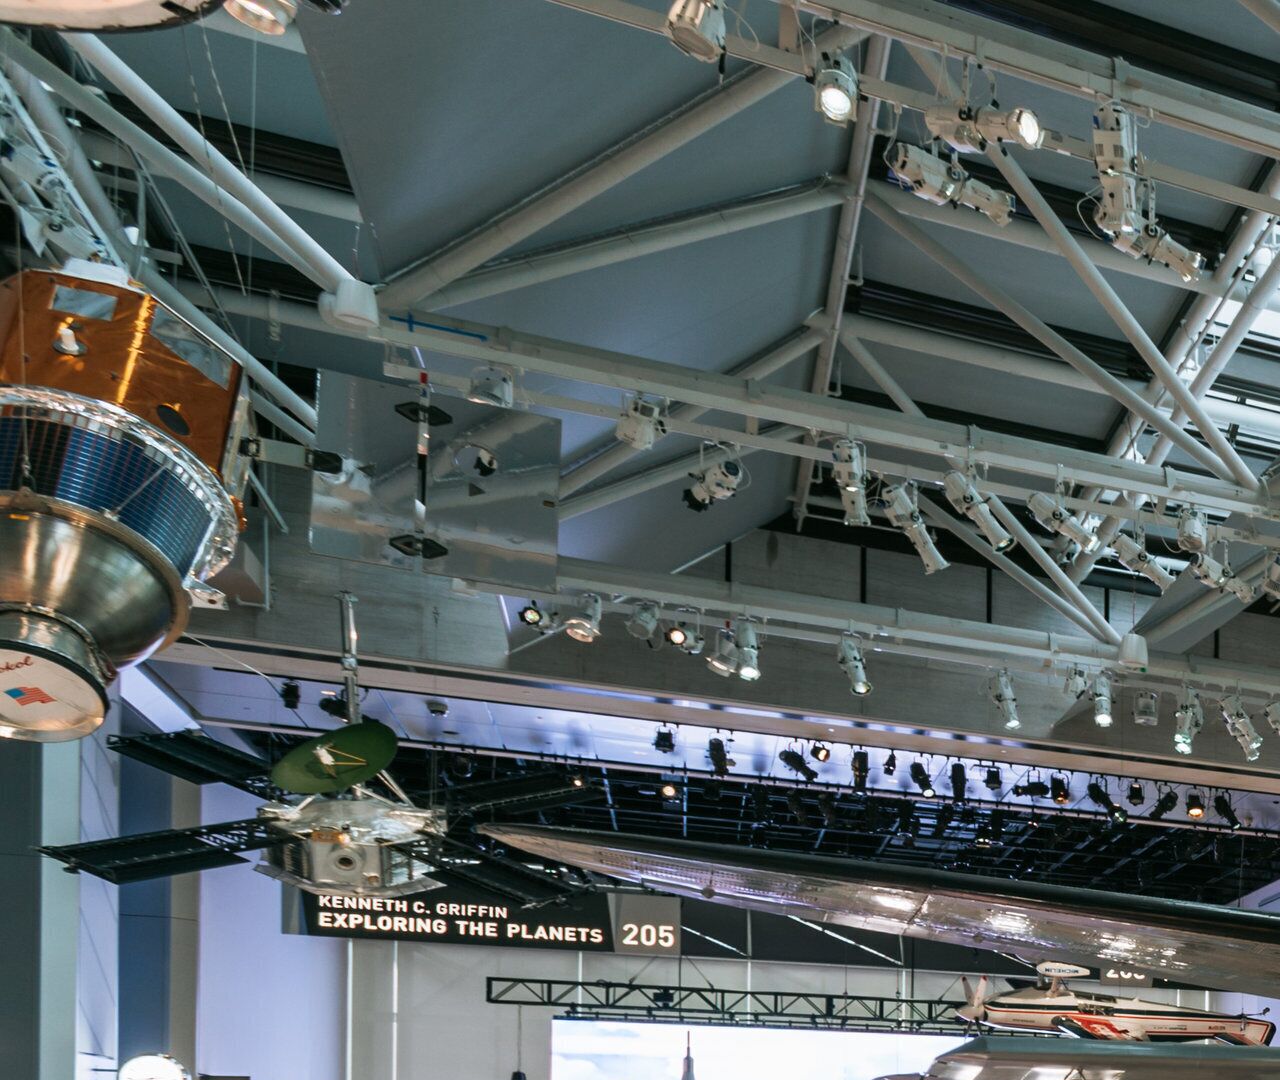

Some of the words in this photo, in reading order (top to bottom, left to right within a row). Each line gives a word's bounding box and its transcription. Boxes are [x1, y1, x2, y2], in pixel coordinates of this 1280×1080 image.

[318, 894, 409, 913] KENNETH
[413, 901, 431, 914] C.
[436, 903, 508, 919] GRIFFIN
[318, 912, 447, 934] EXPLORING
[456, 921, 498, 937] THE
[507, 924, 604, 944] PLANETS
[622, 924, 675, 947] 205
